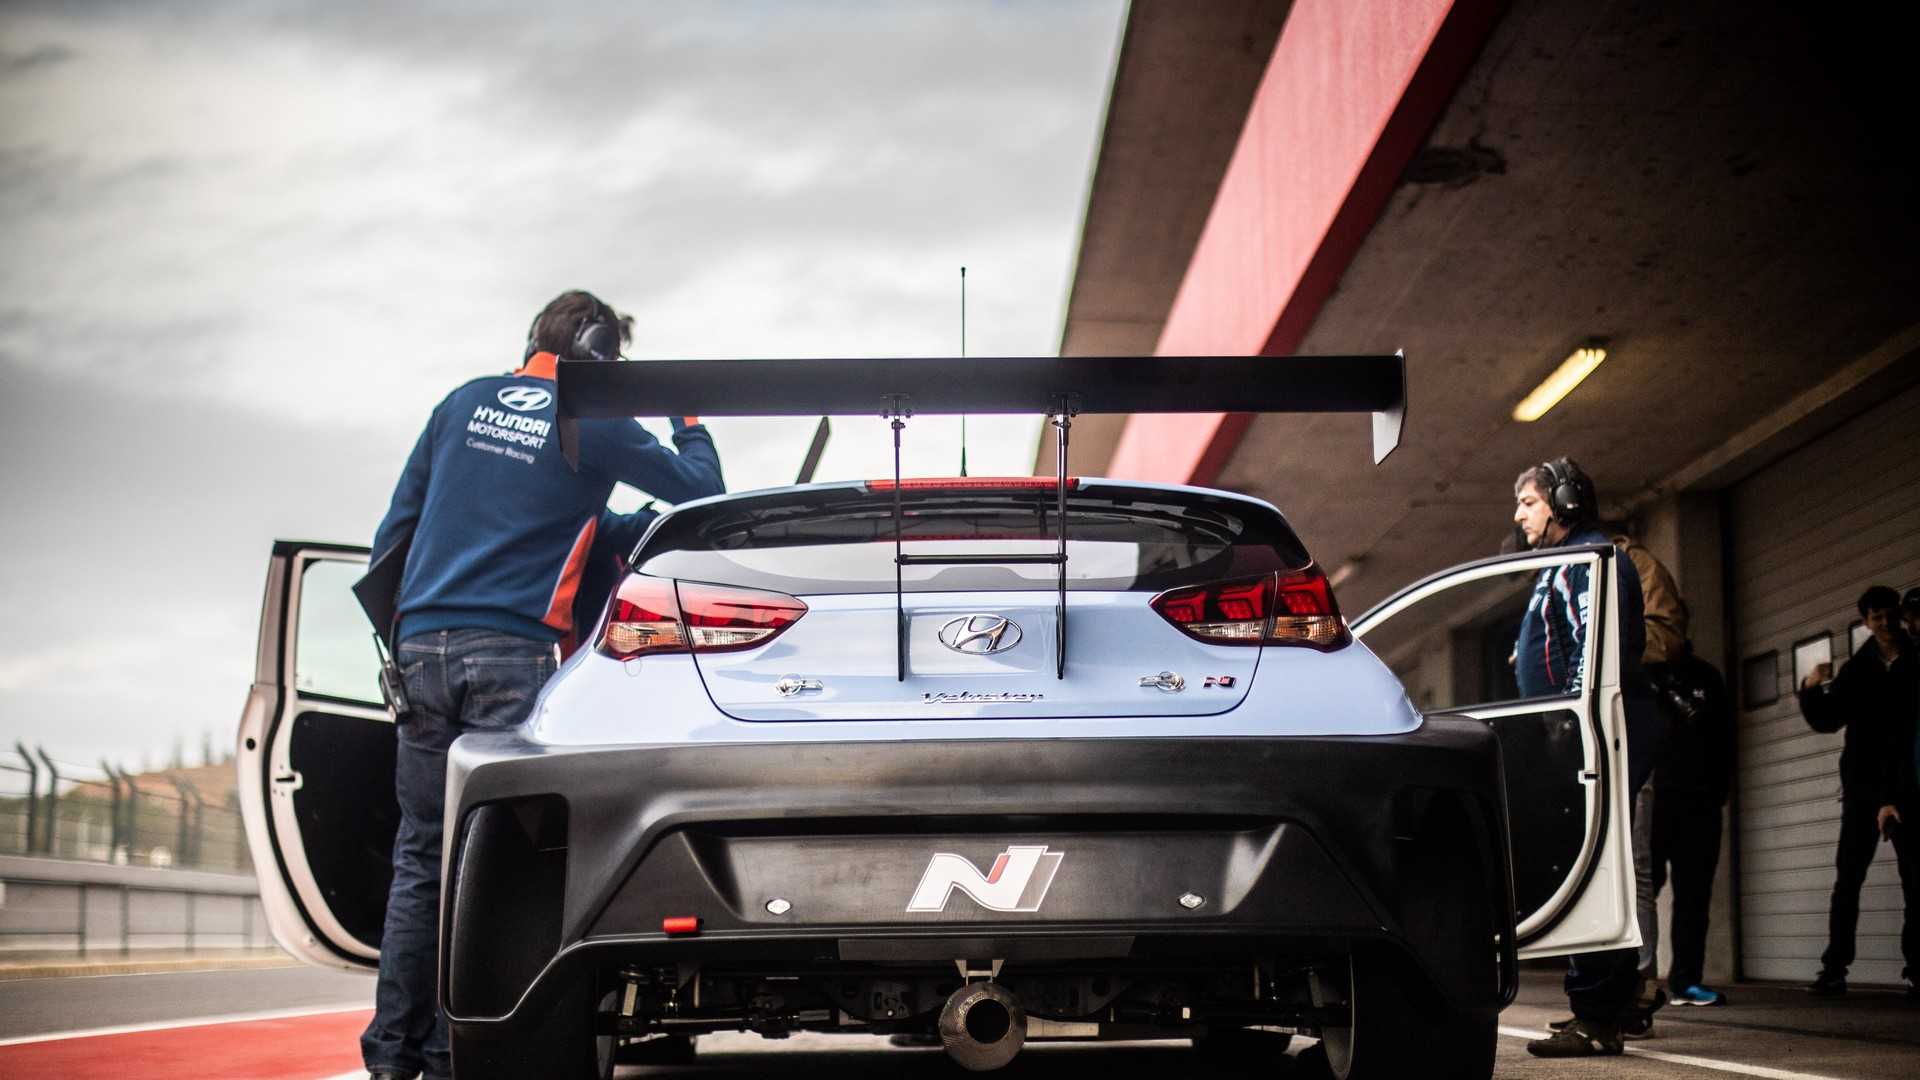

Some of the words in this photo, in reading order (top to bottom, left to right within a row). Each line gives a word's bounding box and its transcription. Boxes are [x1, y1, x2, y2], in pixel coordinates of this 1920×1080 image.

[467, 421, 546, 449] MOTORSPORT
[473, 405, 551, 436] HYUNDAI
[466, 438, 504, 453] Customer
[505, 447, 535, 464] Racing
[906, 846, 1064, 912] N
